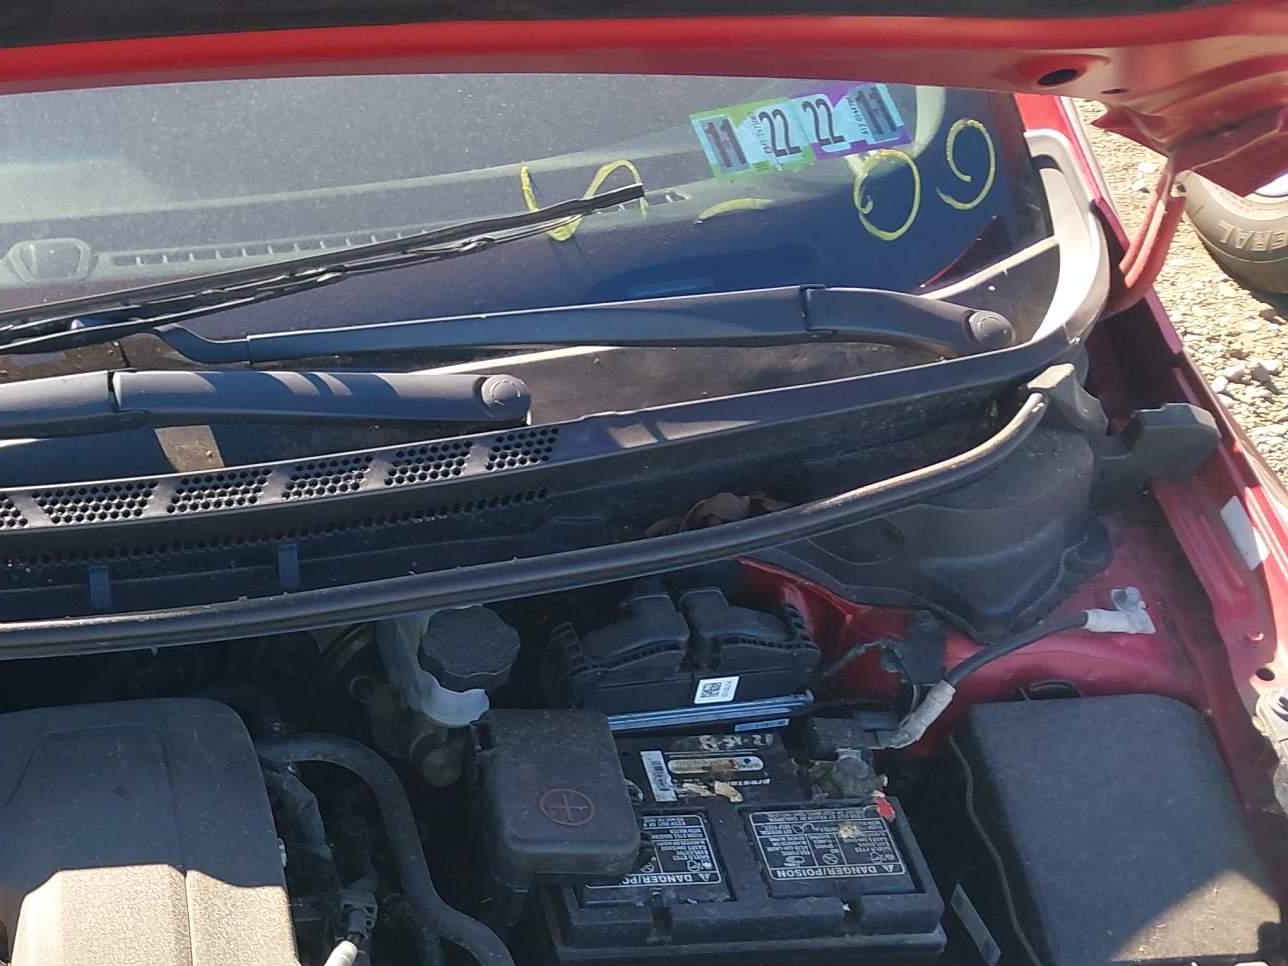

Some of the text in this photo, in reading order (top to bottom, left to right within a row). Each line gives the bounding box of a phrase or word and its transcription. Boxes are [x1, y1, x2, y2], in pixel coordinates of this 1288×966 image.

[759, 108, 802, 158] 22
[802, 97, 845, 146] 22
[776, 865, 878, 878] DANGER/POISON
